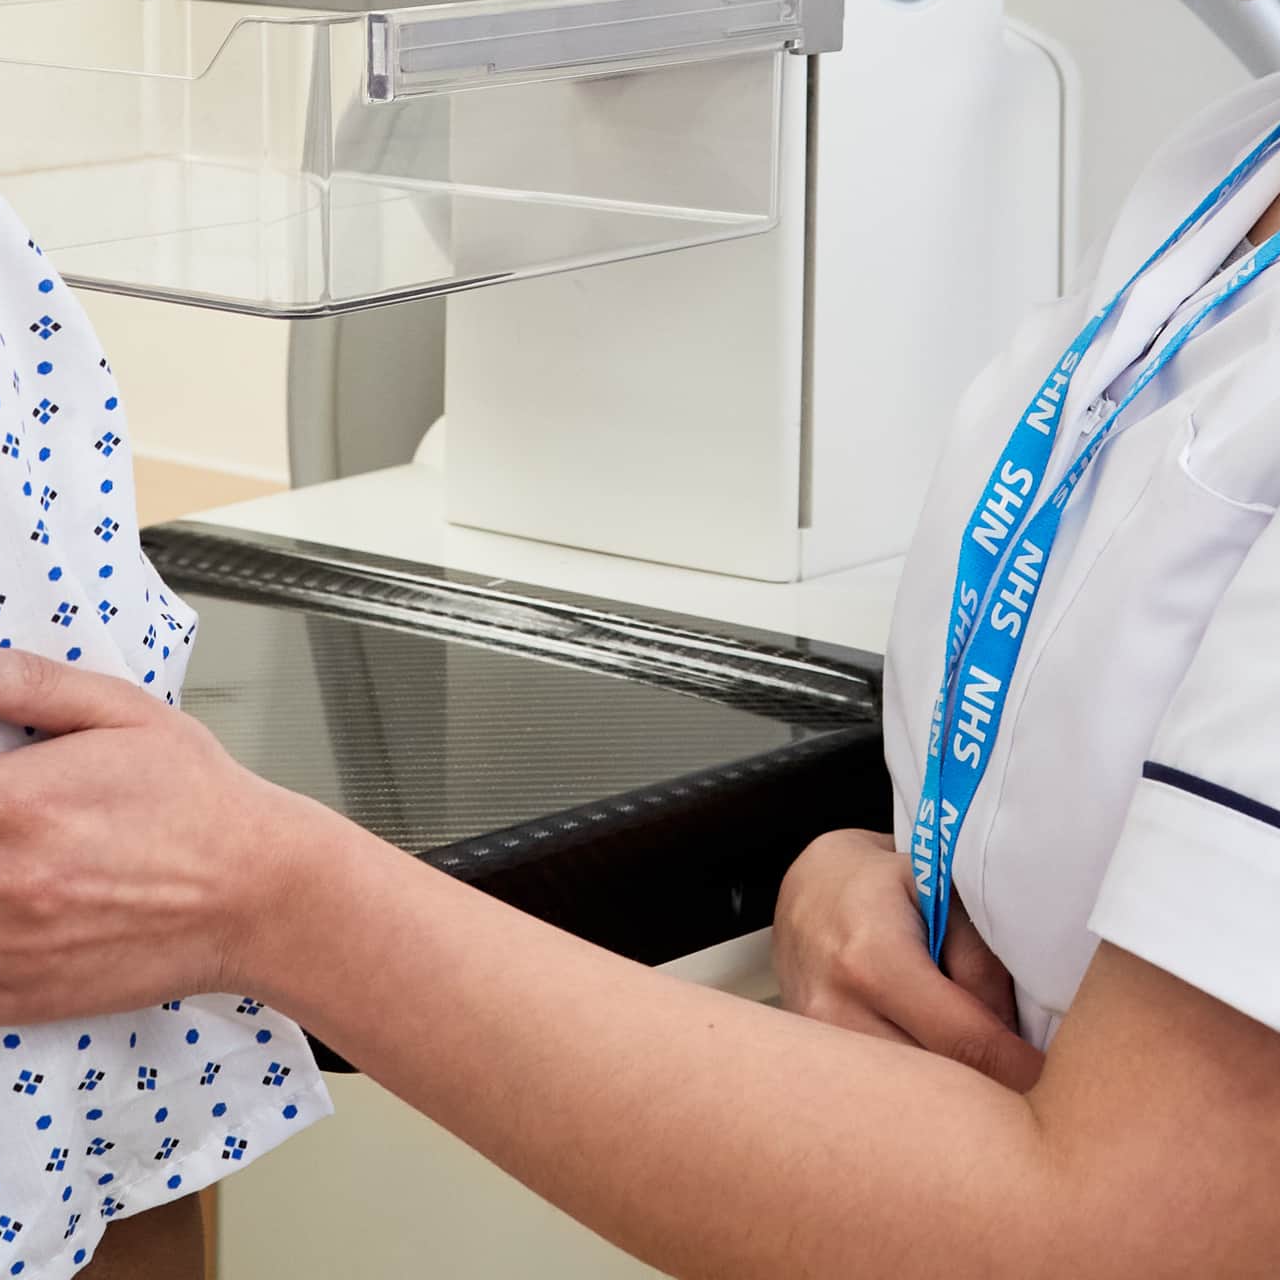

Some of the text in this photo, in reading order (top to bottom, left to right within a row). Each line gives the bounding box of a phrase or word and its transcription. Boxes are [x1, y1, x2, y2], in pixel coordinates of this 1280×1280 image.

[914, 798, 935, 897] NHS
[972, 460, 1034, 556] NHS
[1026, 351, 1080, 436] NHS
[991, 538, 1045, 639] NHS
[953, 665, 1002, 769] NHS
